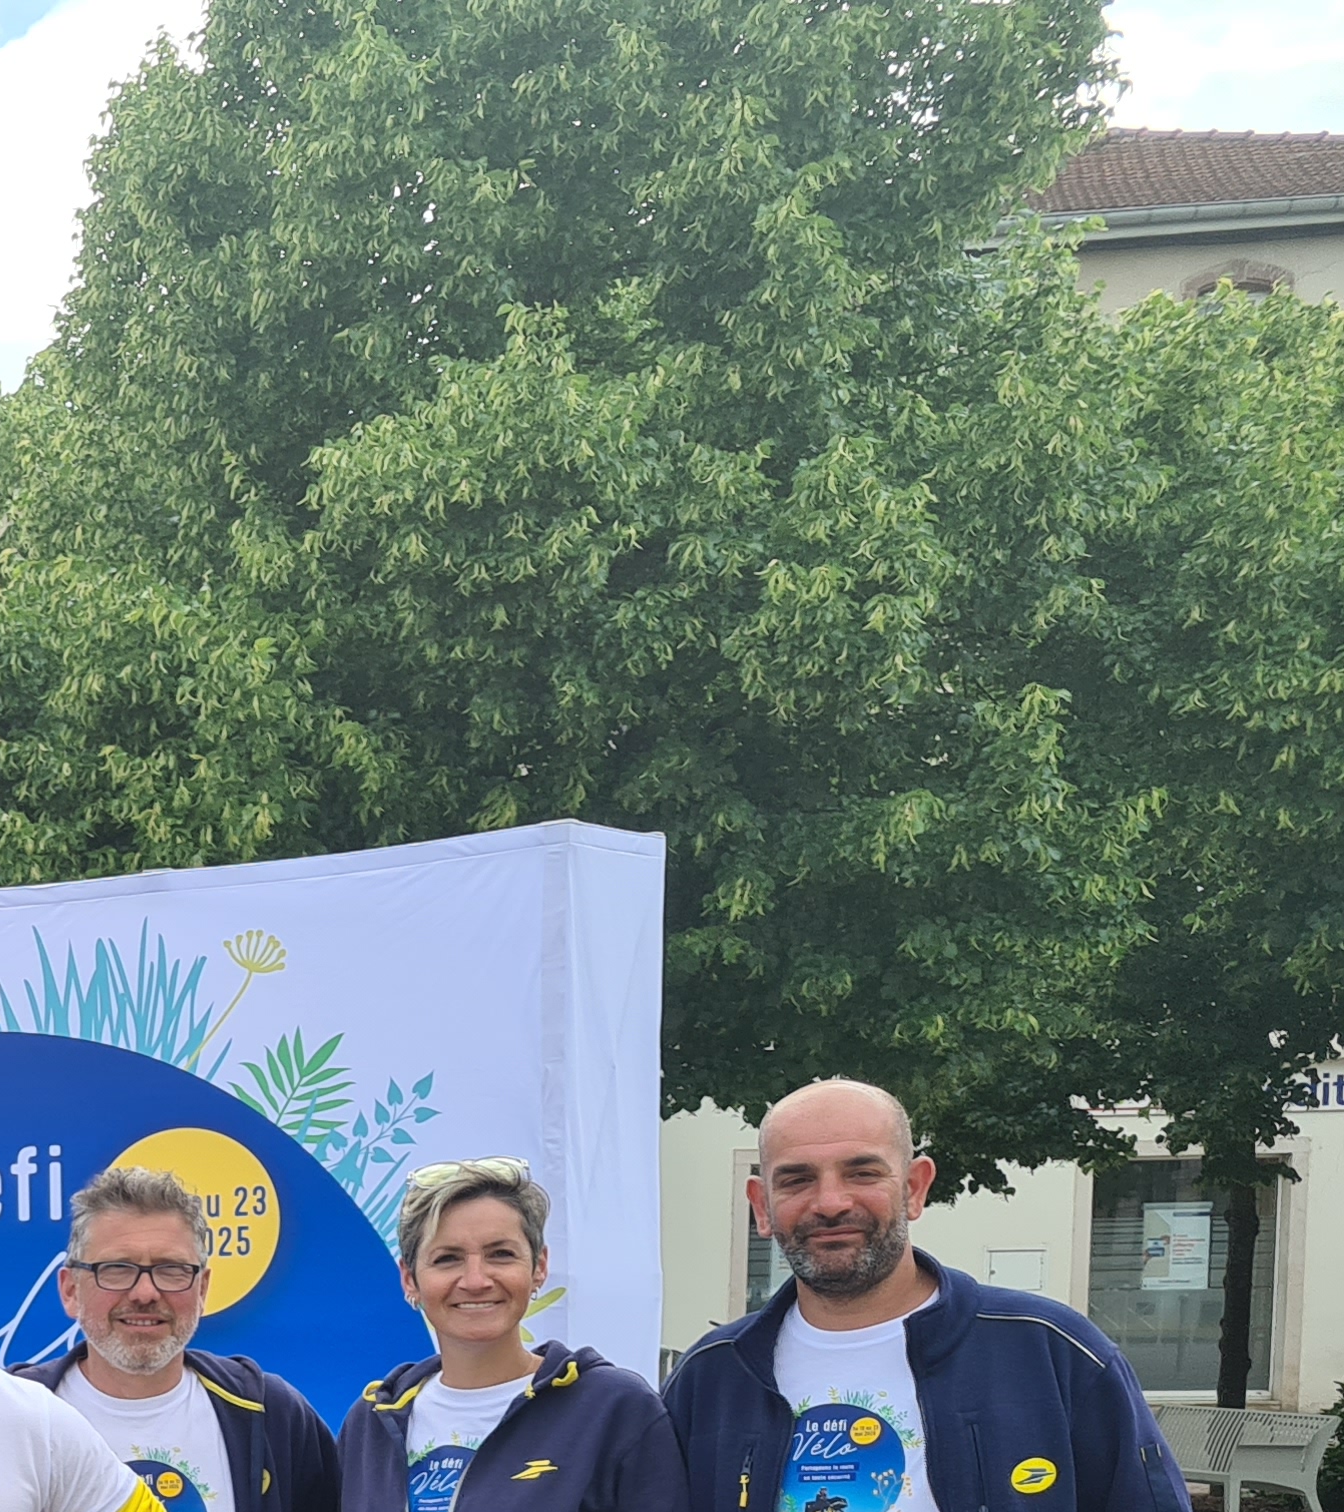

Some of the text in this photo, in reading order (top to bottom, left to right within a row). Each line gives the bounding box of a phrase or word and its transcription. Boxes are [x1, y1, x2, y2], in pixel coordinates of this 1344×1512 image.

[234, 1185, 266, 1216] 23
[806, 1419, 847, 1432] Le défi
[793, 1432, 857, 1461] Vélo
